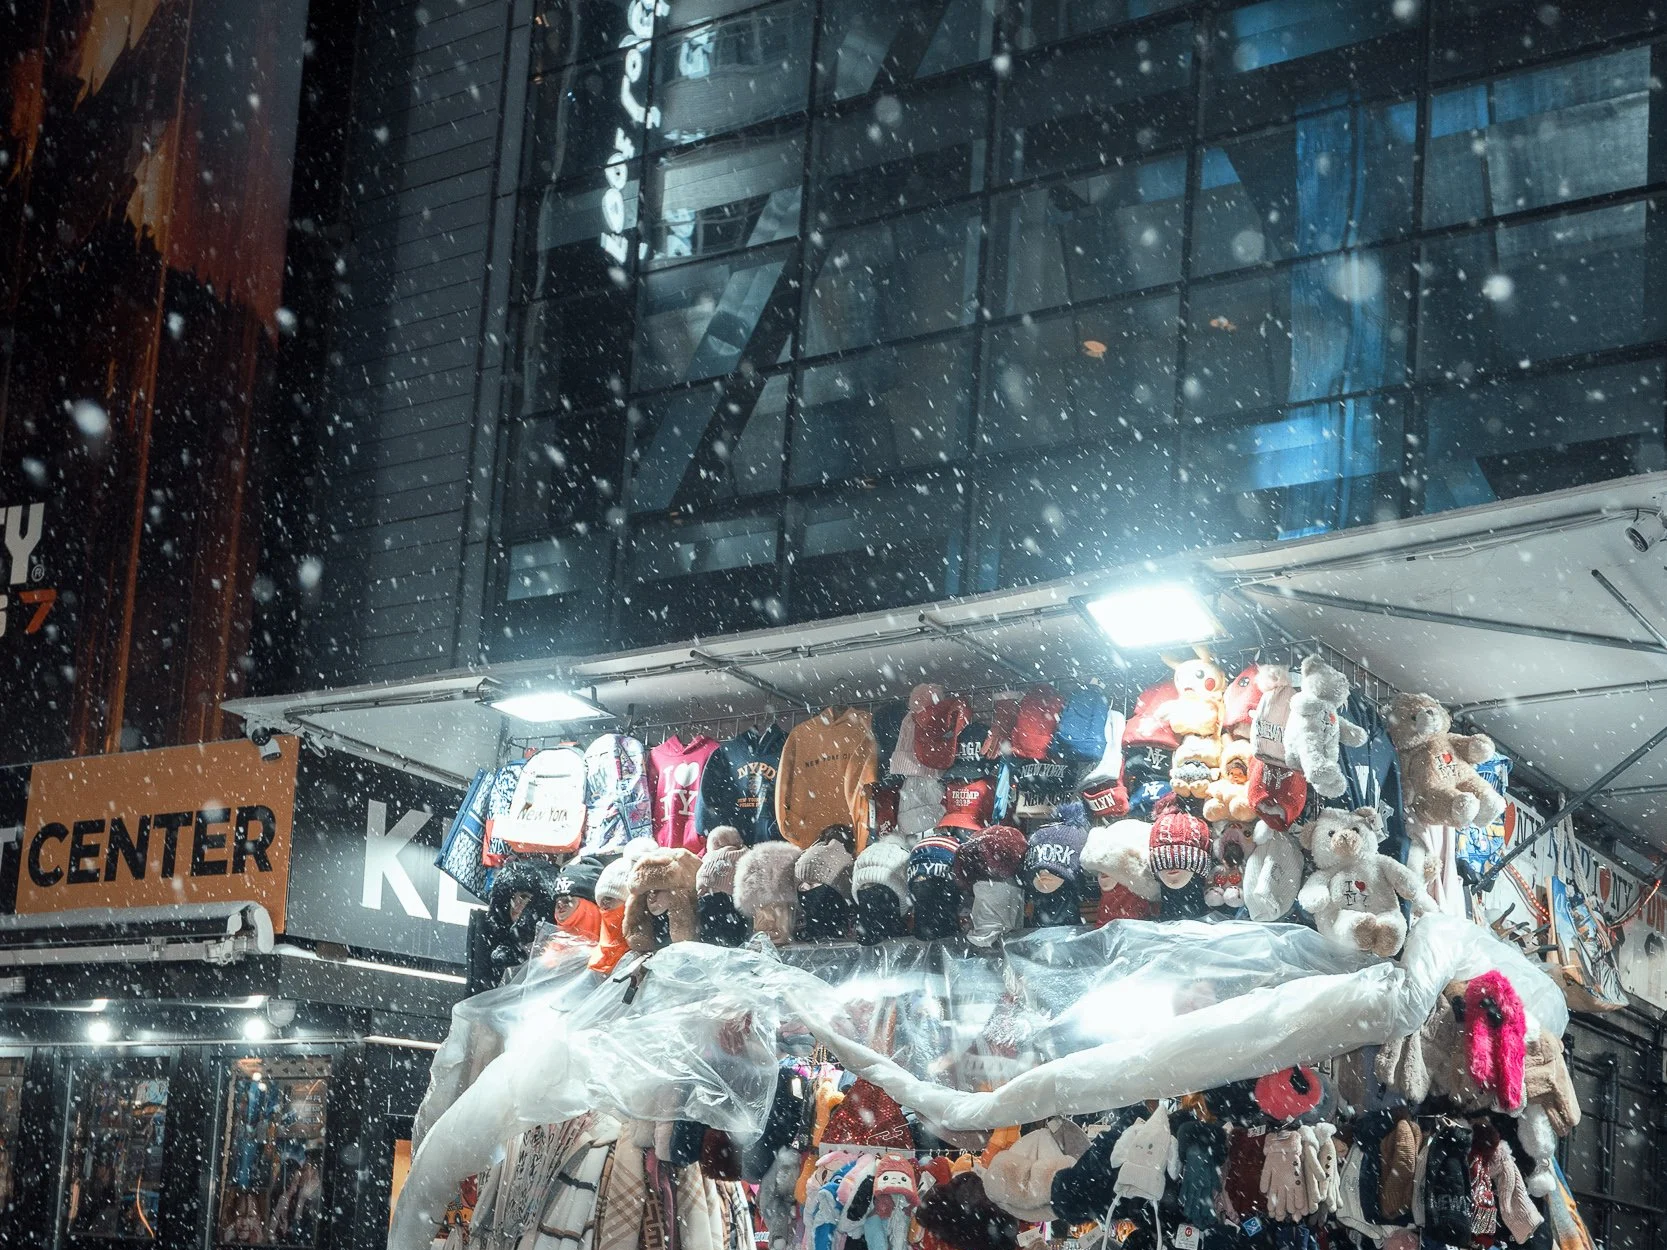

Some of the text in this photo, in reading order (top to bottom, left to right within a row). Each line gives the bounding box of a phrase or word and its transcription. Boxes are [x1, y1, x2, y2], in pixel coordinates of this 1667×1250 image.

[737, 761, 777, 780] NYPD
[1020, 763, 1042, 779] NEW
[1040, 762, 1068, 779] YORK
[951, 791, 979, 800] TRUMP
[1141, 780, 1164, 800] NY
[28, 804, 276, 888] CENTER
[1034, 843, 1075, 866] YORK
